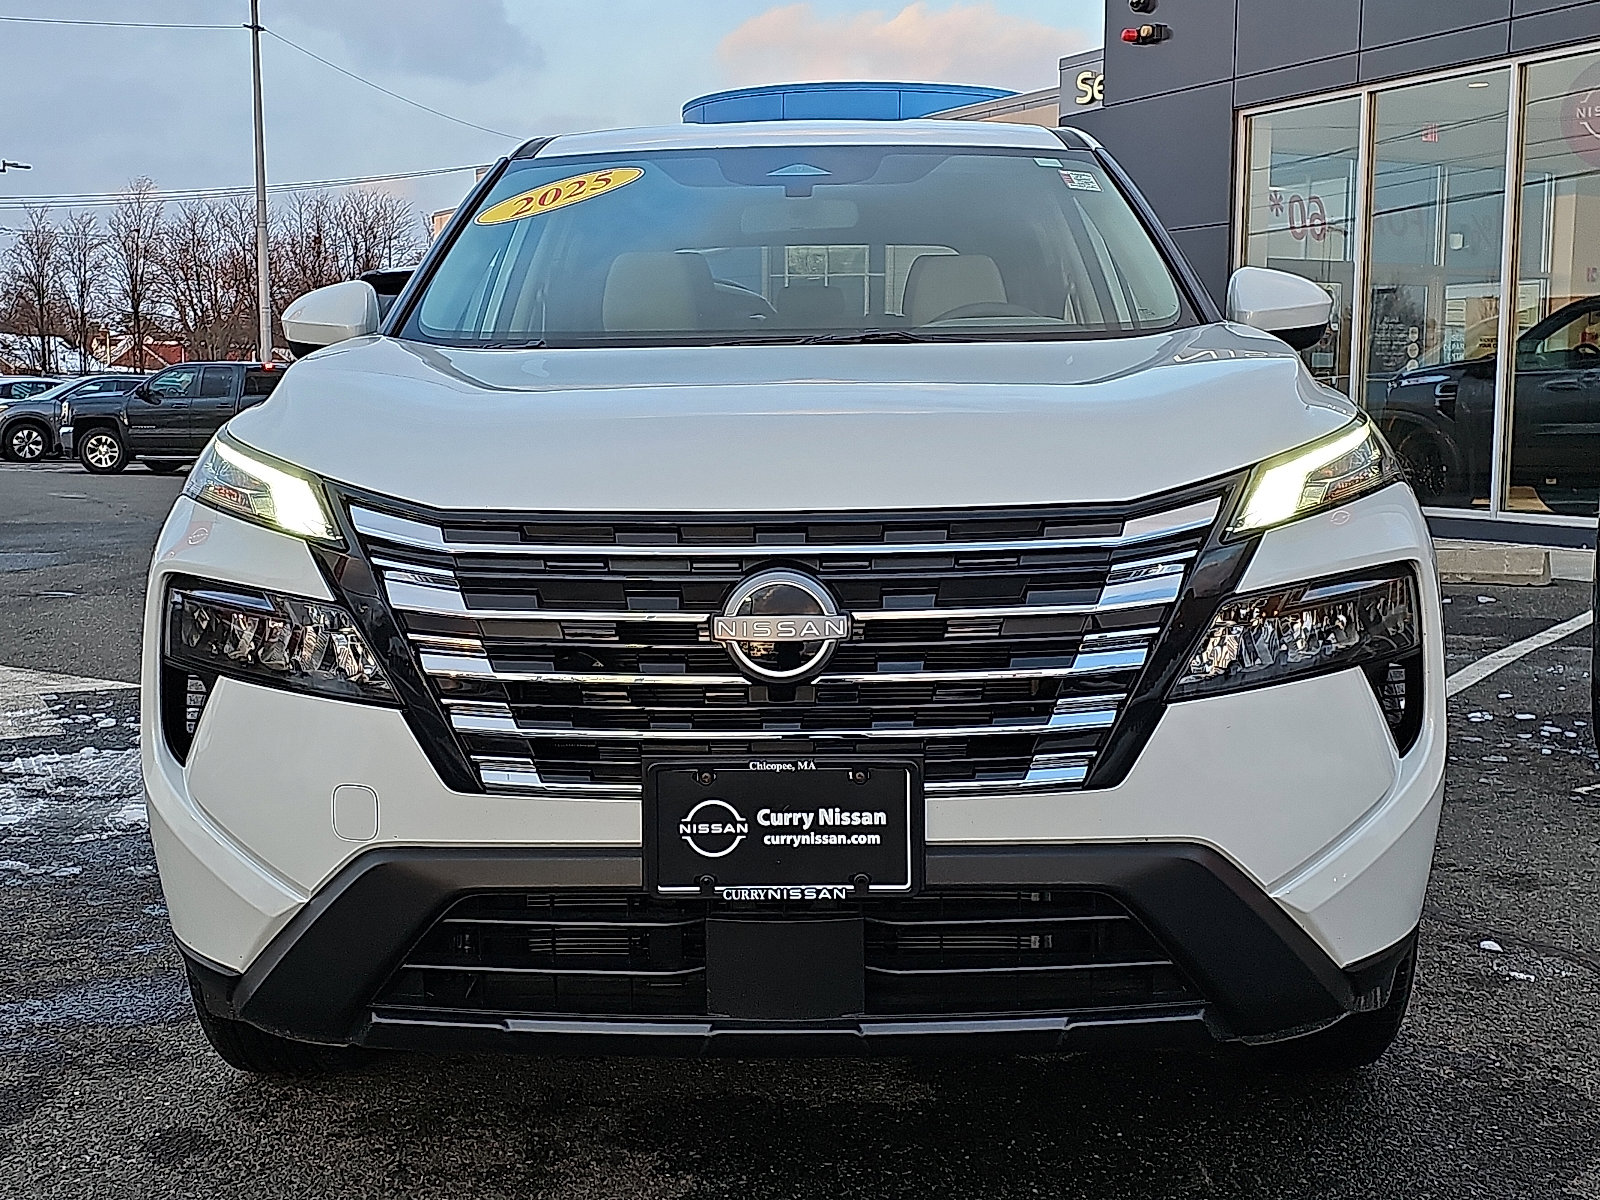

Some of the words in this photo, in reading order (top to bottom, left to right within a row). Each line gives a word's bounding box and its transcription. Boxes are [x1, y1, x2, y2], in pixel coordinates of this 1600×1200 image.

[510, 171, 614, 218] 2025
[717, 620, 845, 637] NISSAN
[749, 761, 795, 772] Chicopee,
[797, 761, 817, 770] MA
[756, 808, 814, 829] Curry
[818, 808, 887, 826] Nissan
[679, 823, 749, 834] NISSAN
[763, 832, 881, 847] currynissan.com
